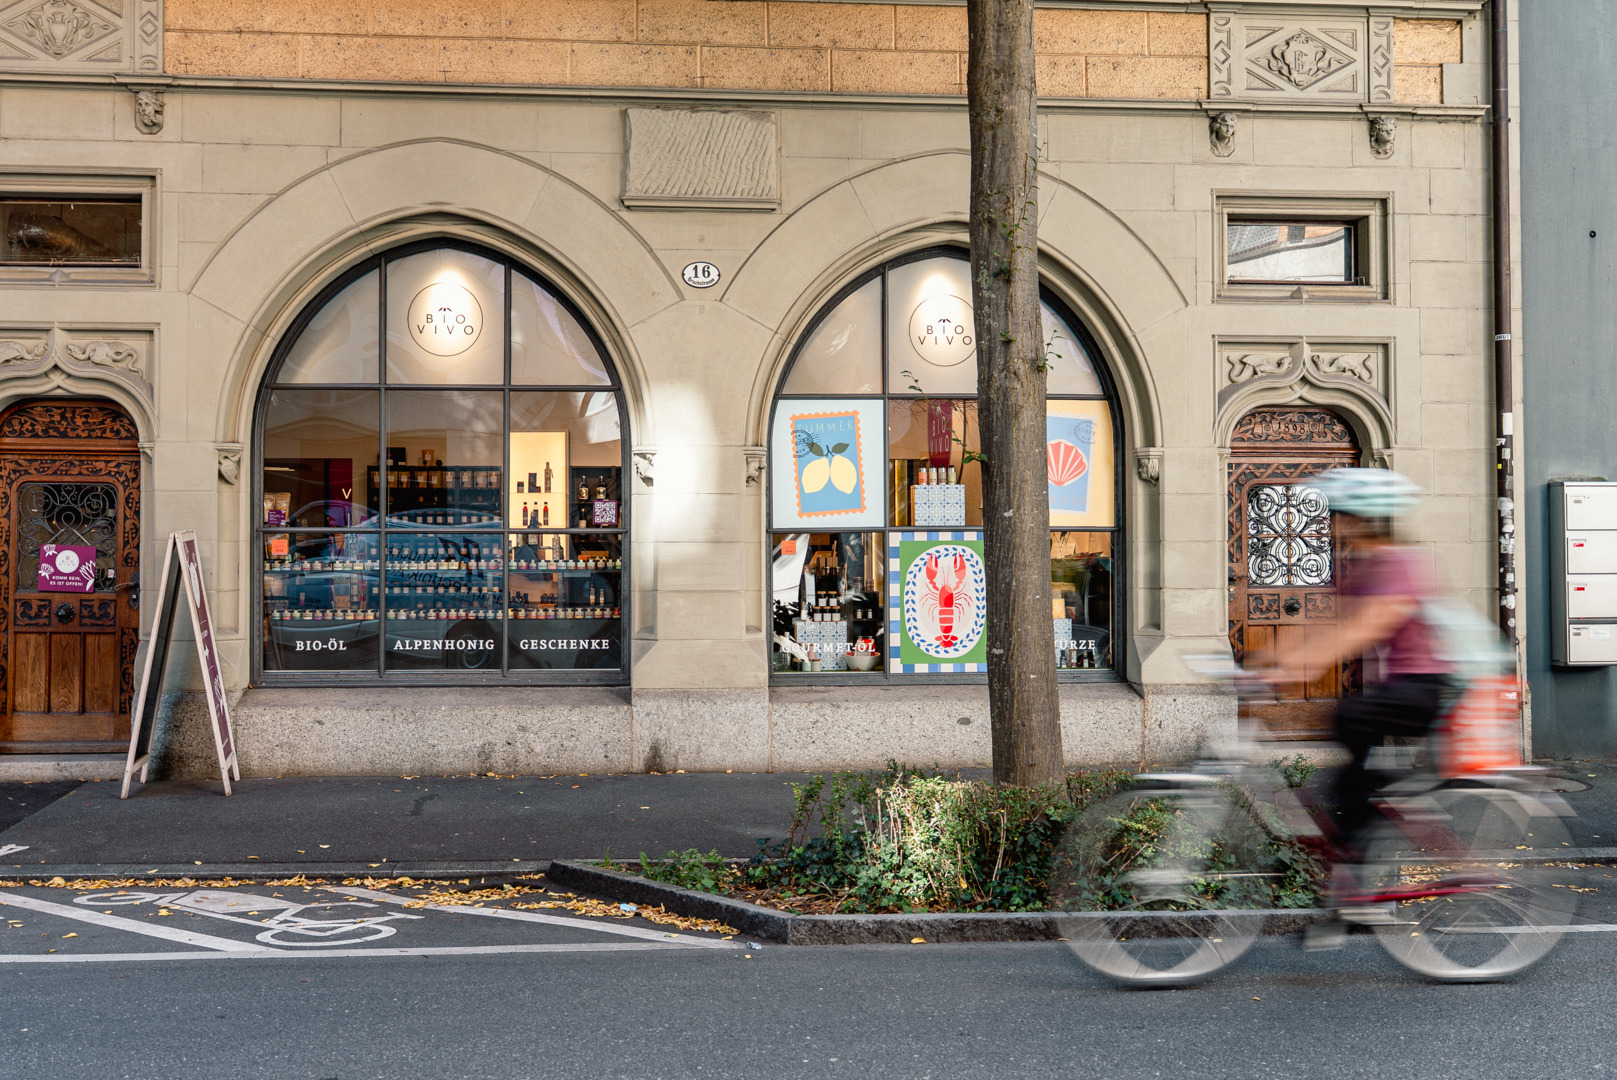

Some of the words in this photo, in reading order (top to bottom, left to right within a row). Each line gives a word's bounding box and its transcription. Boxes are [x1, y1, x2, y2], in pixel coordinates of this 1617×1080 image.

[692, 264, 711, 279] 16
[426, 313, 466, 324] BIO
[416, 324, 474, 336] VIVO
[926, 324, 965, 335] BIO
[917, 335, 972, 346] VIVO
[797, 420, 854, 434] SUMMER
[932, 416, 947, 437] BIO
[930, 434, 949, 456] VIVO
[1049, 493, 1086, 507] ALIA
[295, 638, 347, 651] BIO-ÖL
[393, 638, 495, 651] ALPENHONIG
[519, 638, 610, 651] GESCHENKE
